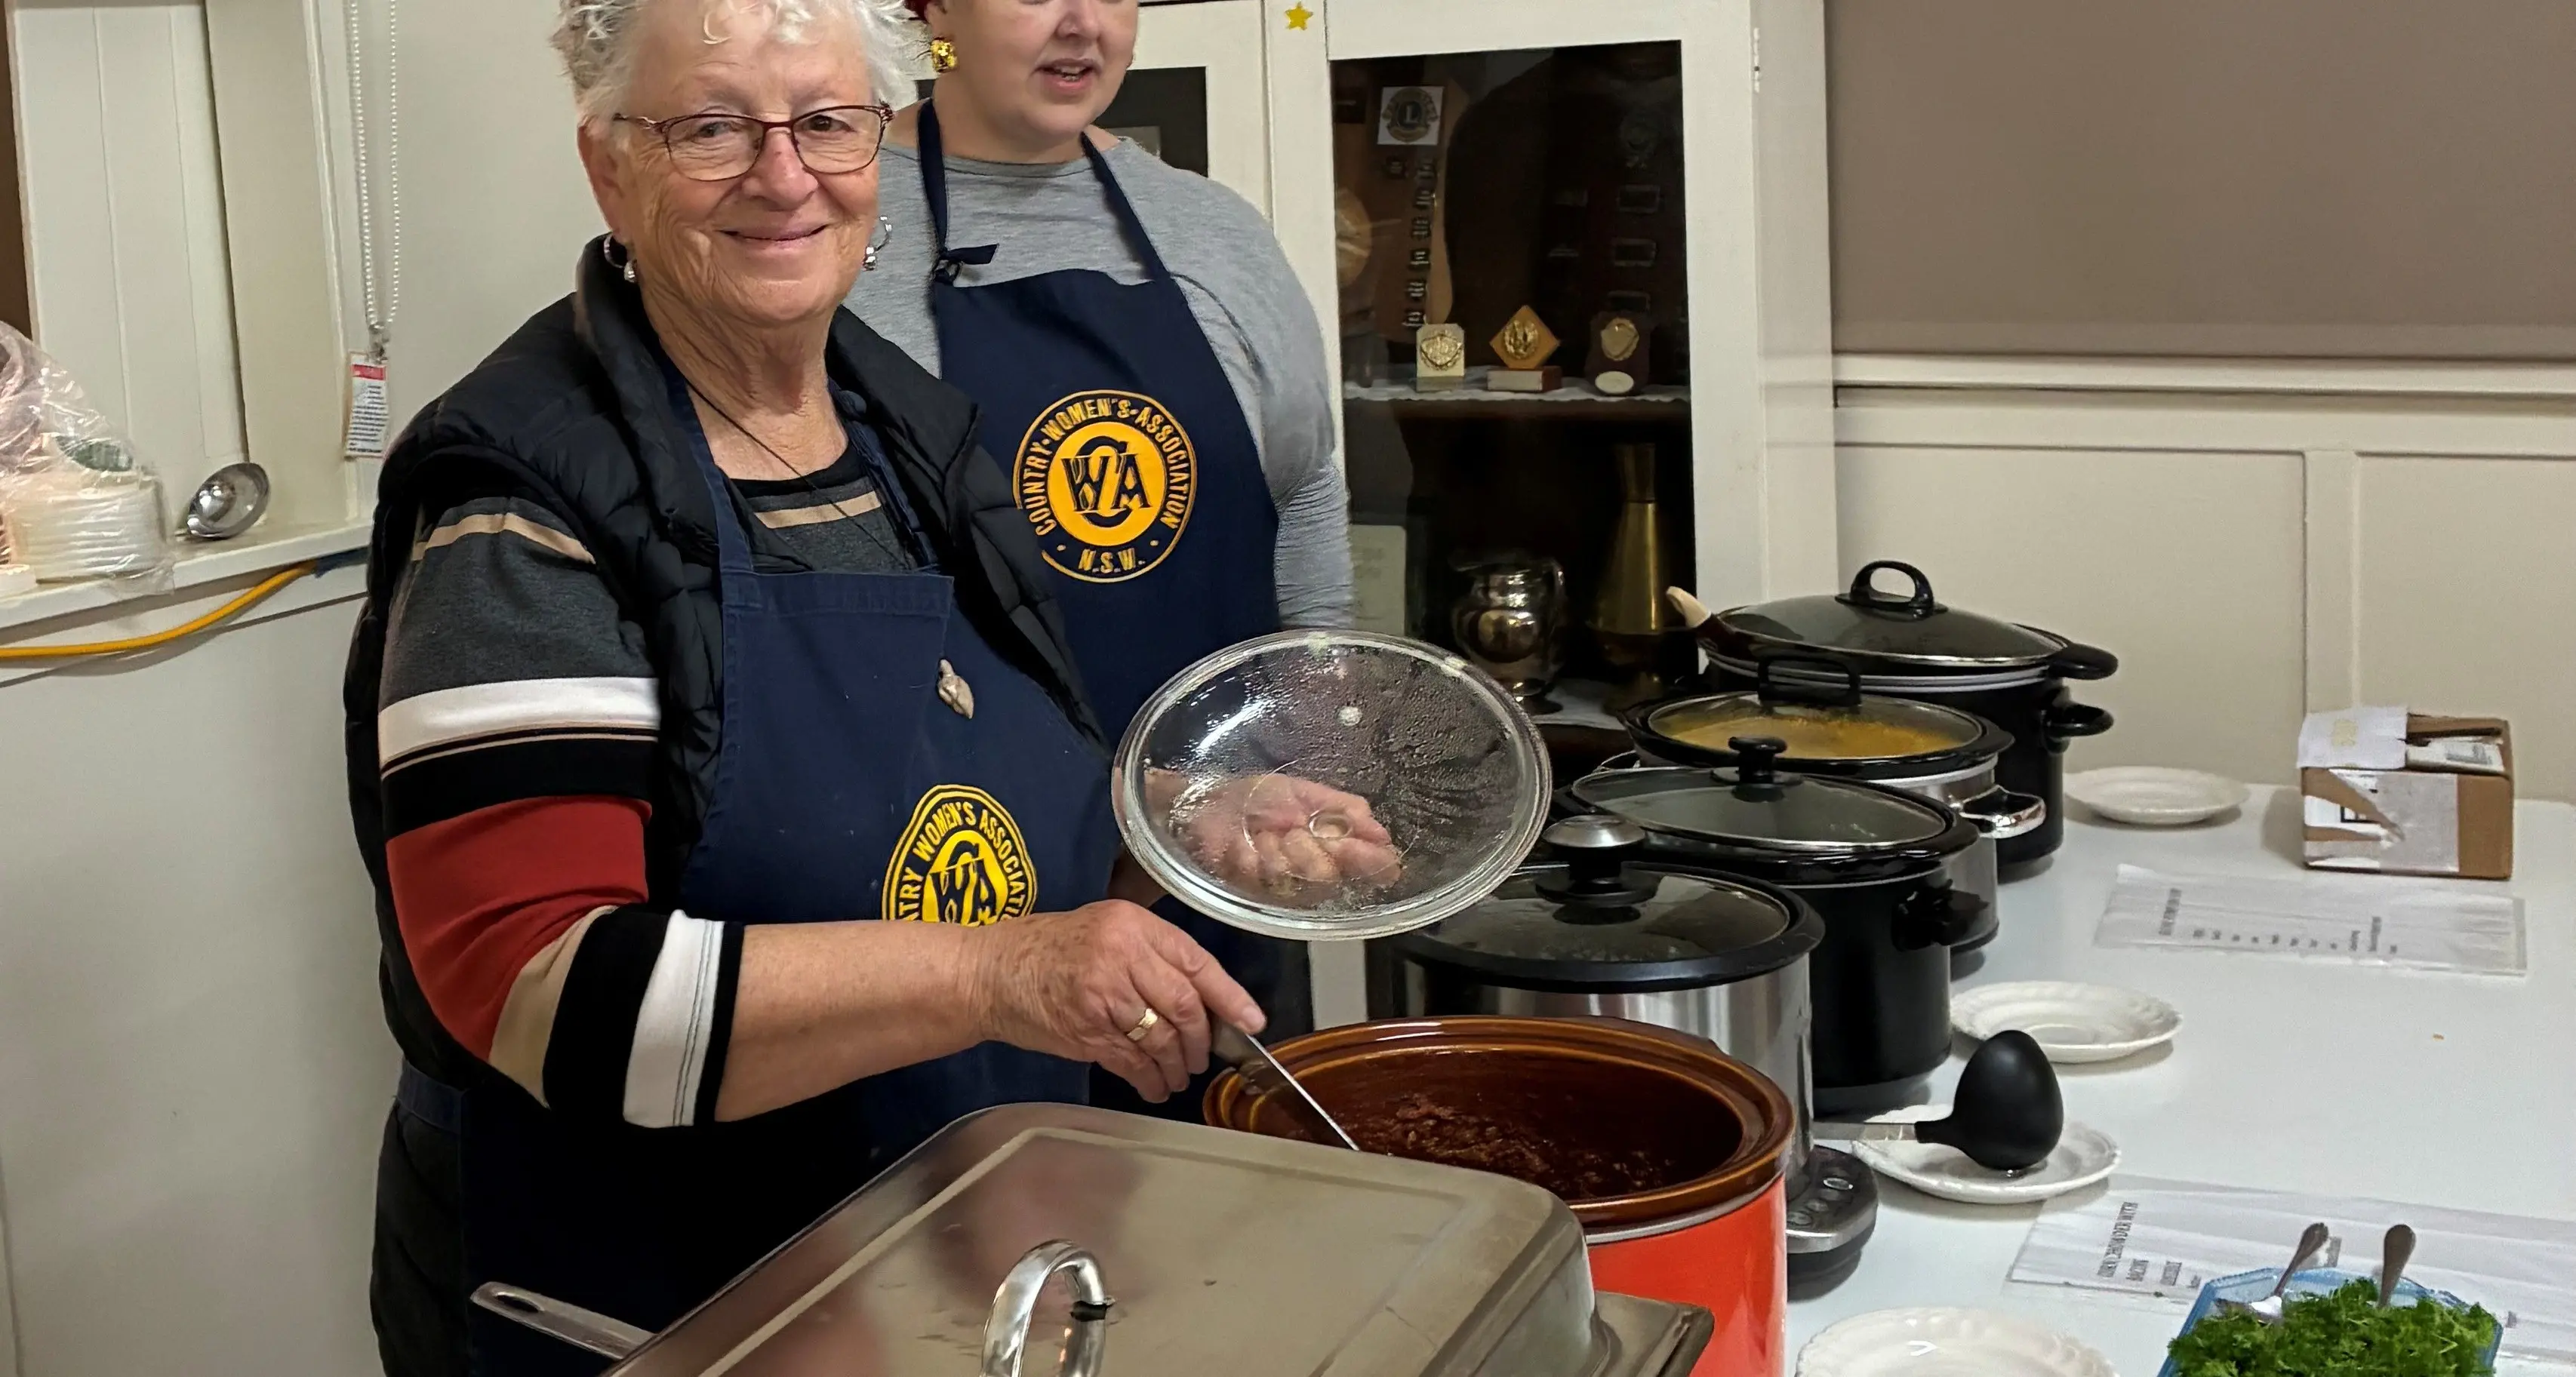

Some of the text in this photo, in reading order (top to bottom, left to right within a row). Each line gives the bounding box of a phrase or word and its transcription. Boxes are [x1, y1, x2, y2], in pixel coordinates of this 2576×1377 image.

[1023, 398, 1190, 536] COUNTRY WOMEN'S ASSOCIATION
[1078, 549, 1146, 573] N.S.W.
[913, 802, 977, 862] WOMEN'S
